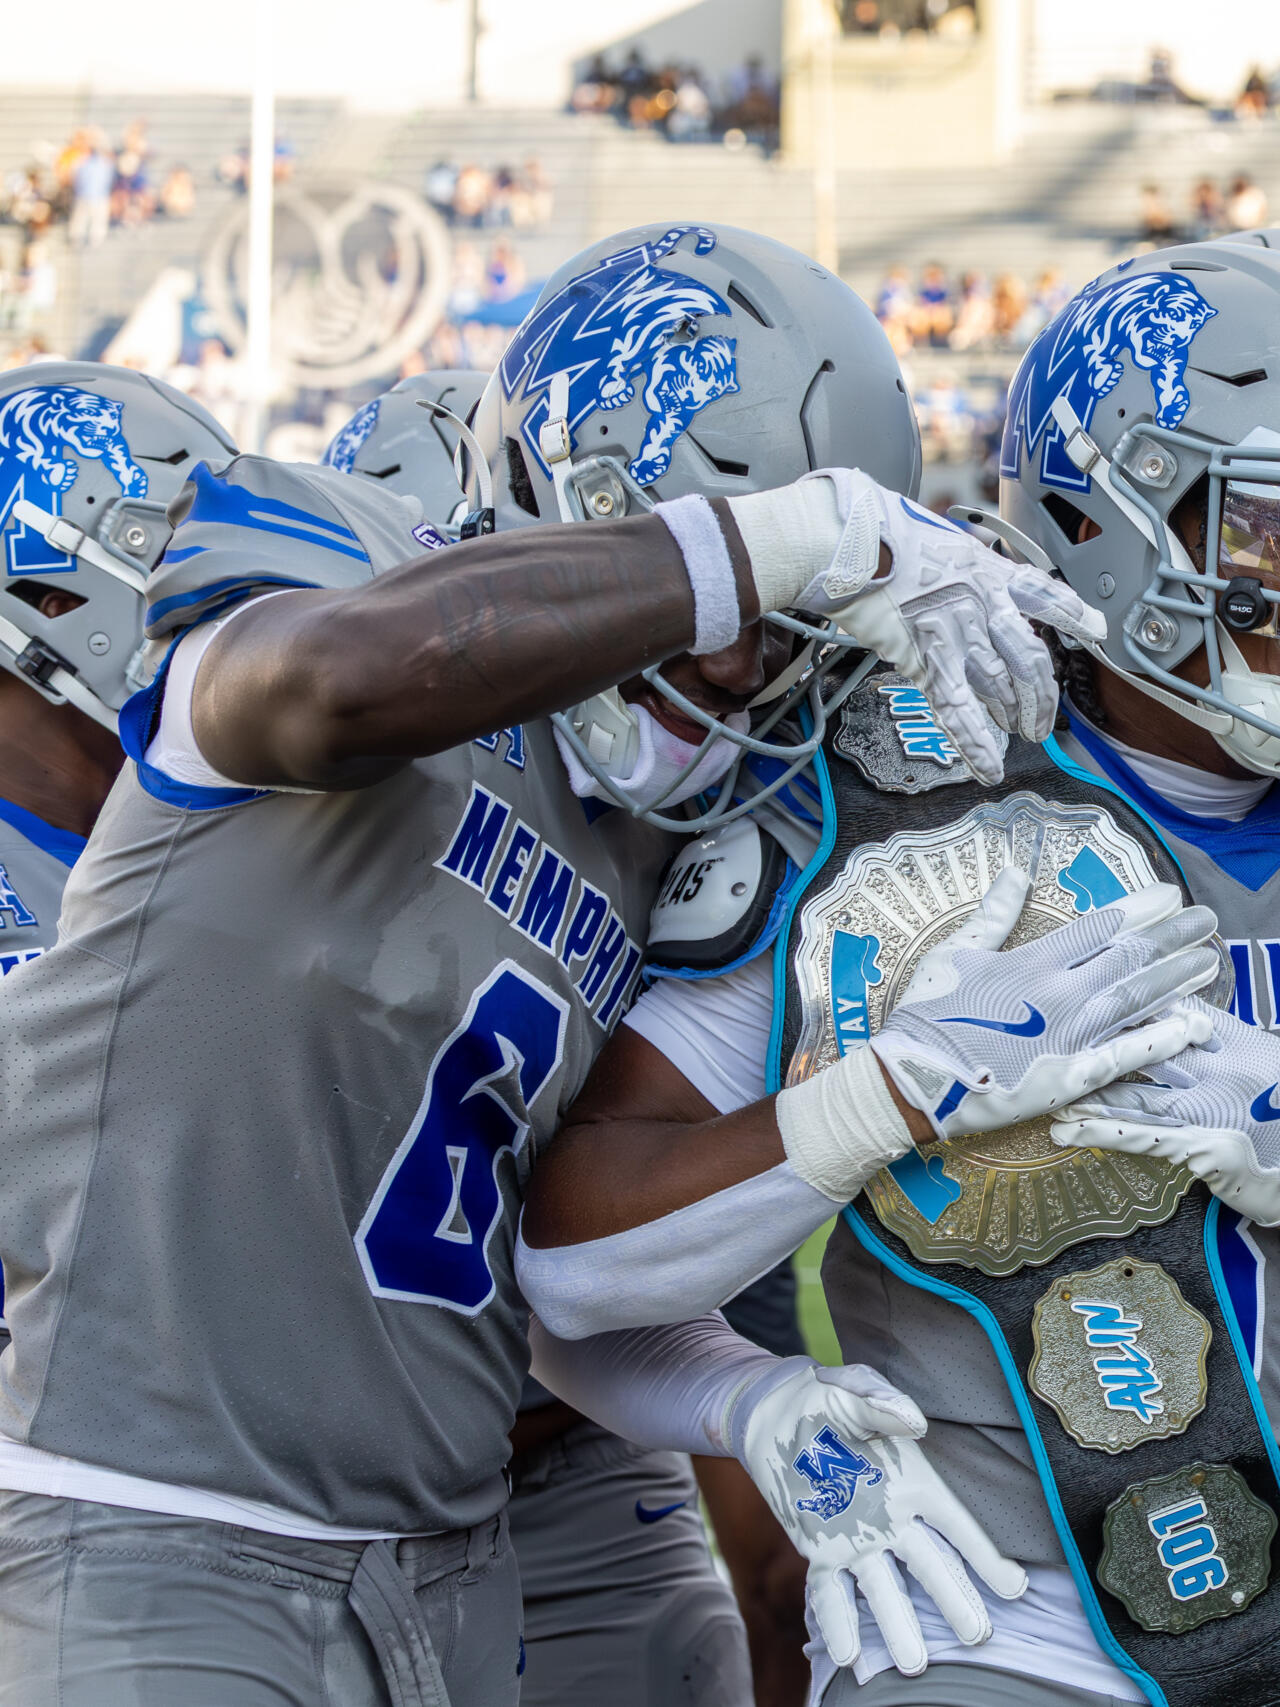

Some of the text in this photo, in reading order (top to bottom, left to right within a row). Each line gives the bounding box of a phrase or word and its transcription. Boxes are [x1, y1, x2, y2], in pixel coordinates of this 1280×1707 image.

[432, 780, 650, 1037] MEMPHI
[353, 957, 571, 1318] 6
[1147, 1498, 1229, 1602] 901
